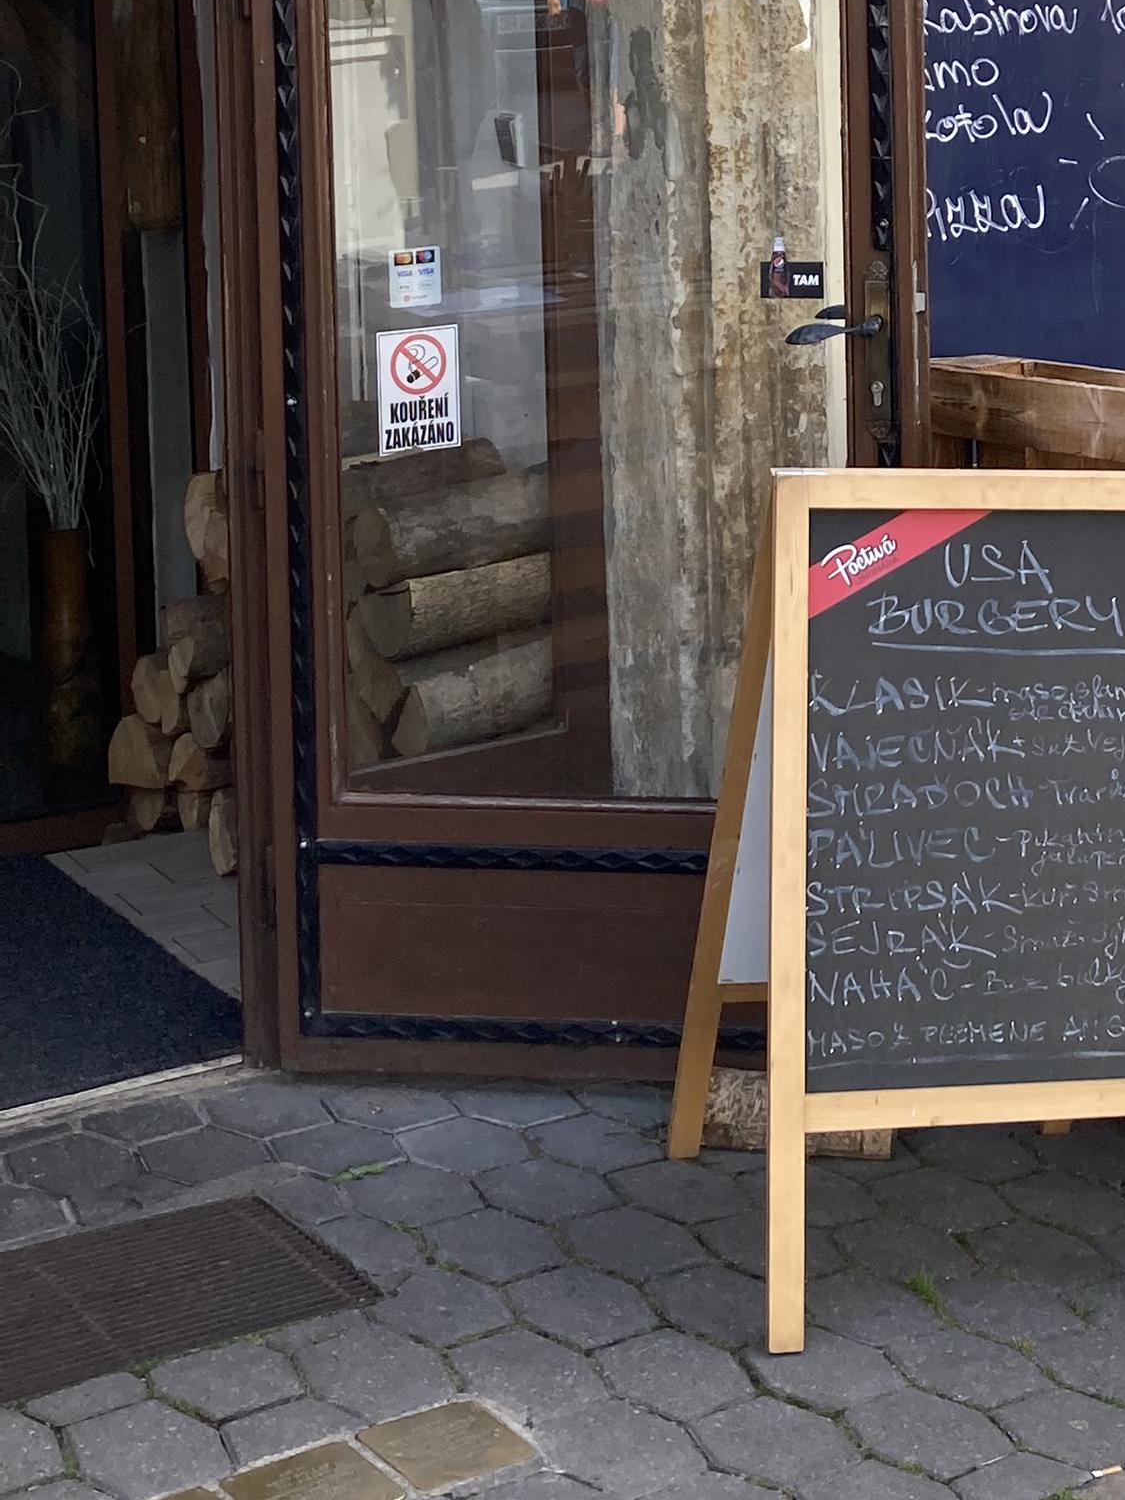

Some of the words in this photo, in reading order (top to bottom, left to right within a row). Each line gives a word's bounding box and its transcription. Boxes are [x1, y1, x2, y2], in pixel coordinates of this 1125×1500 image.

[792, 274, 820, 286] TAM
[389, 392, 449, 424] KOUŘENÍ
[385, 417, 455, 450] ZAKÁZÁNO
[820, 533, 897, 586] Poctivá
[944, 539, 1054, 594] USA
[866, 590, 1124, 637] BURGERY
